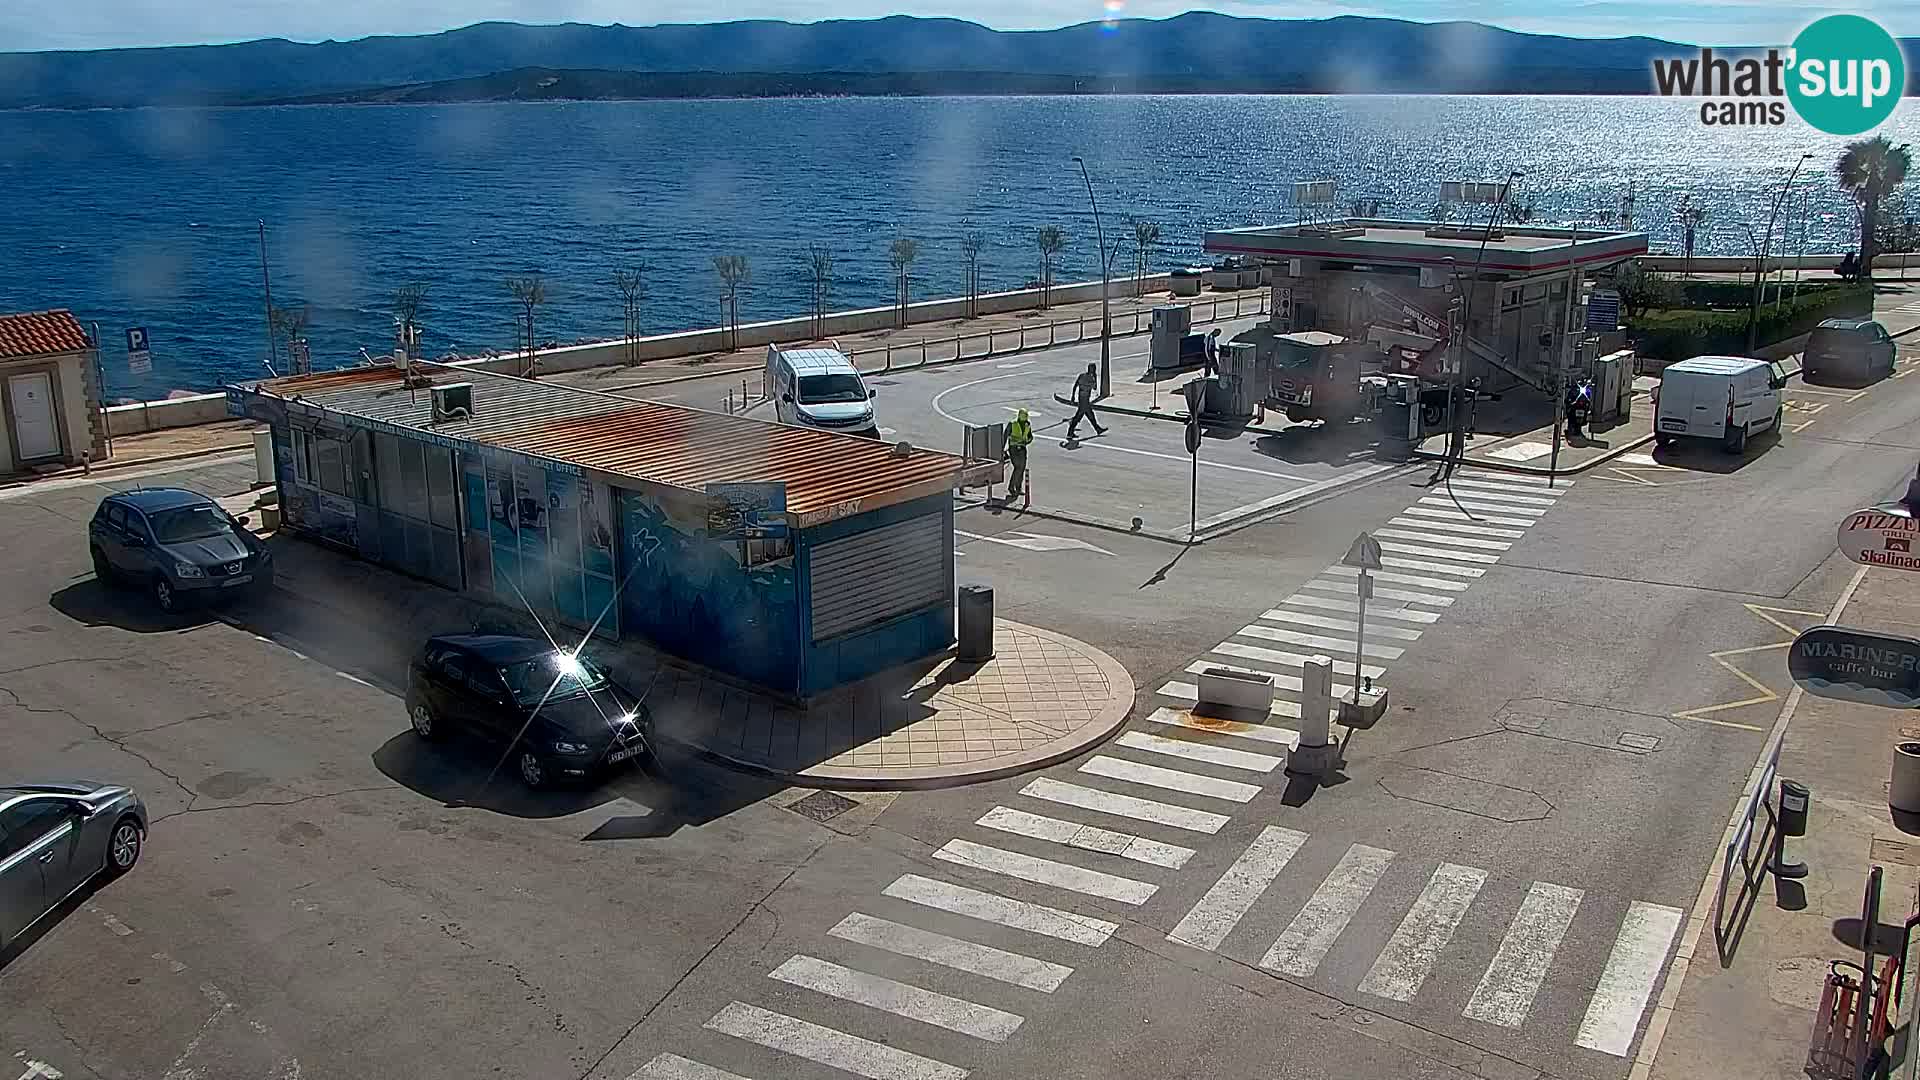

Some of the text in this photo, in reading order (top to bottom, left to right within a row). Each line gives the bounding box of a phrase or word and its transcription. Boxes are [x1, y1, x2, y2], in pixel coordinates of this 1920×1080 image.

[130, 330, 143, 349] P
[1847, 514, 1920, 533] PIZZE
[1870, 666, 1897, 680] bar
